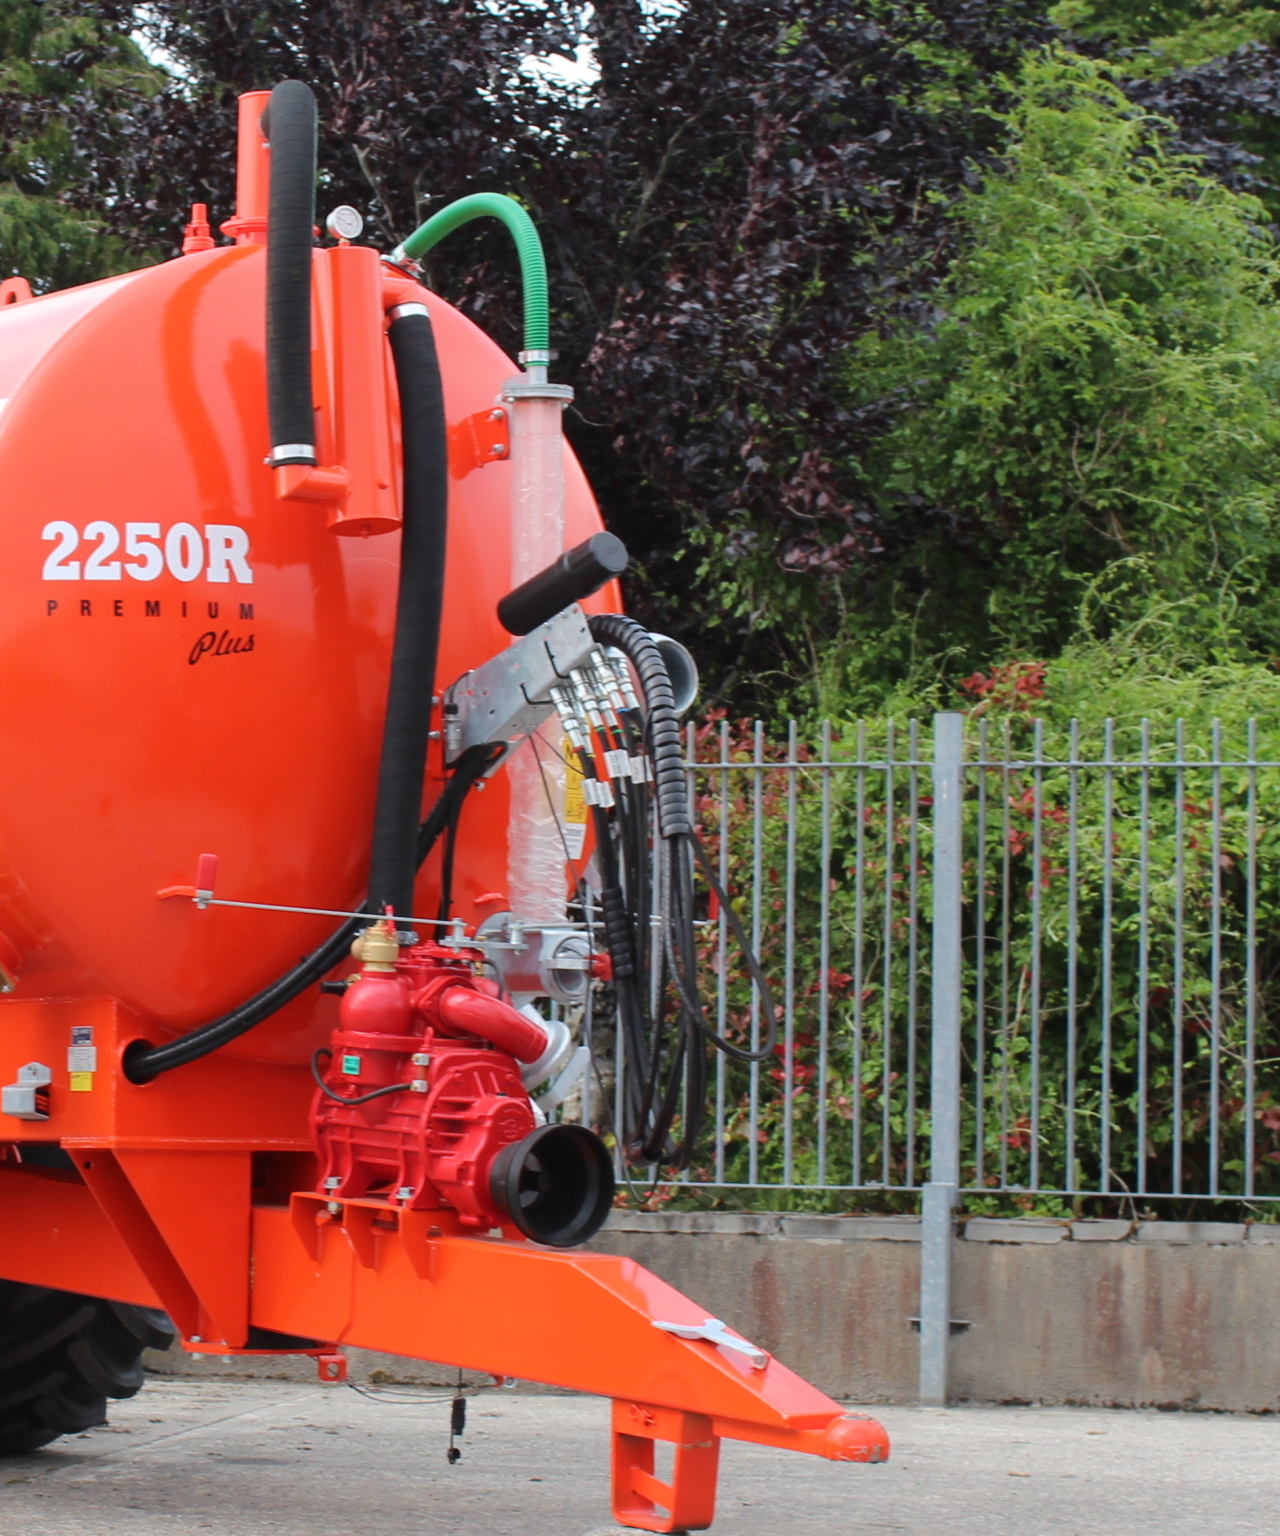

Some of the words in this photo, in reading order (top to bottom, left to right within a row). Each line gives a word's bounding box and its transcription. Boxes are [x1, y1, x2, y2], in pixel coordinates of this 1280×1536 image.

[41, 520, 254, 584] 2250R
[47, 600, 254, 620] PREMIUM
[188, 629, 255, 665] Plus
